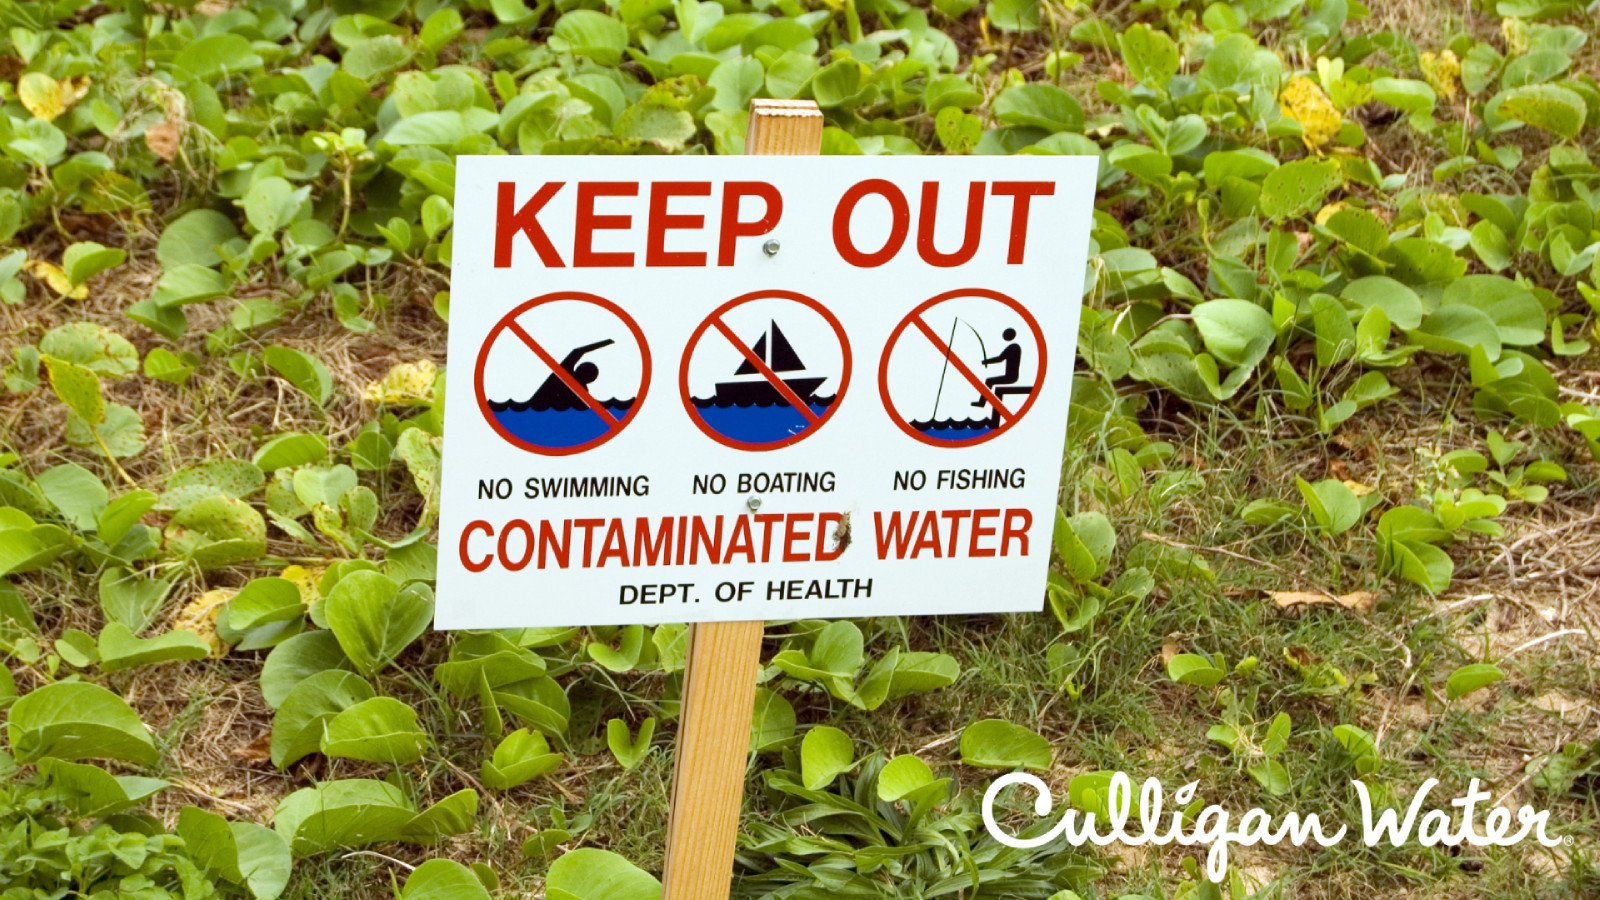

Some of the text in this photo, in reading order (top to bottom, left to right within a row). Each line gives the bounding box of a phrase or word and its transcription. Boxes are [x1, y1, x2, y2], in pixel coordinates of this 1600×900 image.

[494, 179, 1055, 268] KEEP OUT
[478, 475, 649, 500] NO SWIMMING
[692, 471, 836, 495] NO BOATING
[893, 467, 1026, 491] NO FISHING
[459, 509, 1032, 572] CONTAMINATED WATER
[619, 578, 873, 605] DEPT. OF HEALTH
